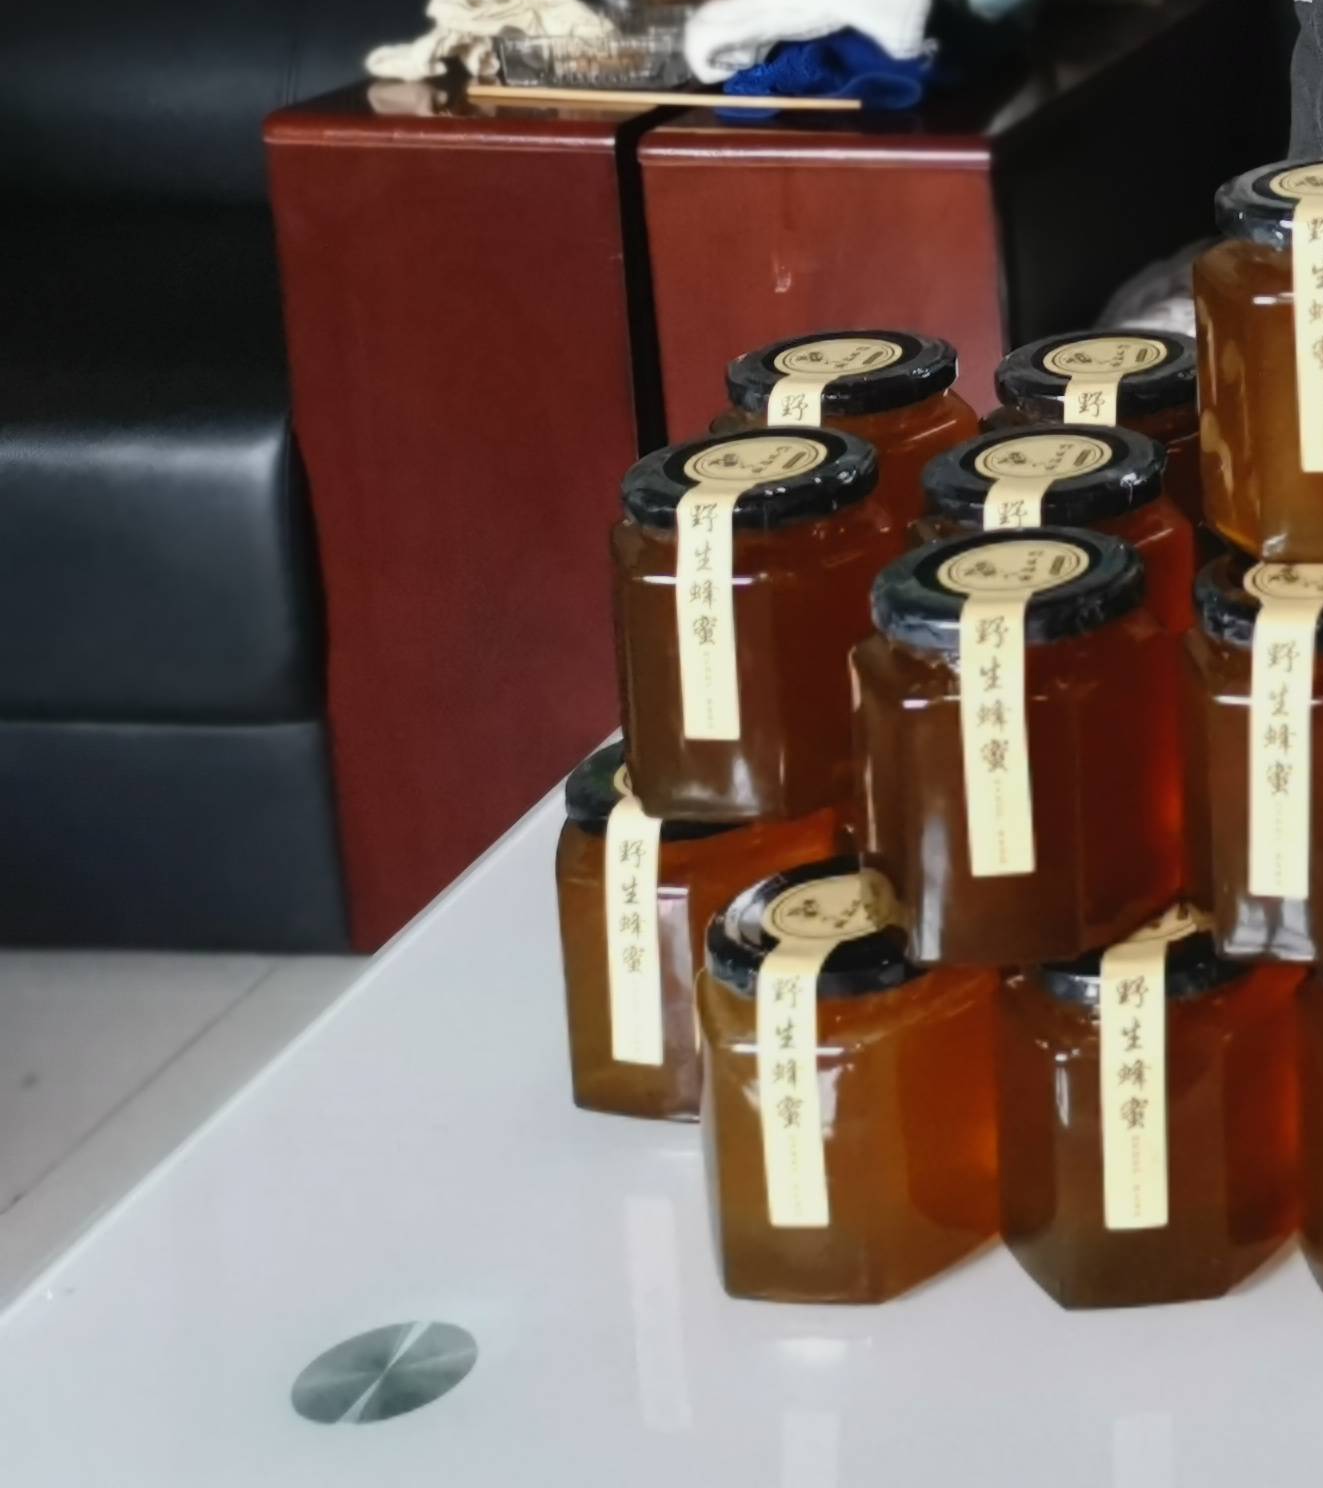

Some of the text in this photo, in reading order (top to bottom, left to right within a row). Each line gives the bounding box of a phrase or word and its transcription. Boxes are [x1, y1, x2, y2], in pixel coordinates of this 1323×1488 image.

[690, 503, 718, 646] 野生蜂蜜
[975, 616, 1009, 774] 野生蜂蜜
[1265, 641, 1299, 796] 野生蜂蜜
[619, 840, 645, 974] 野生蜂蜜
[772, 977, 802, 1130] 野生蜂蜜
[1116, 976, 1150, 1131] 野生蜂蜜
